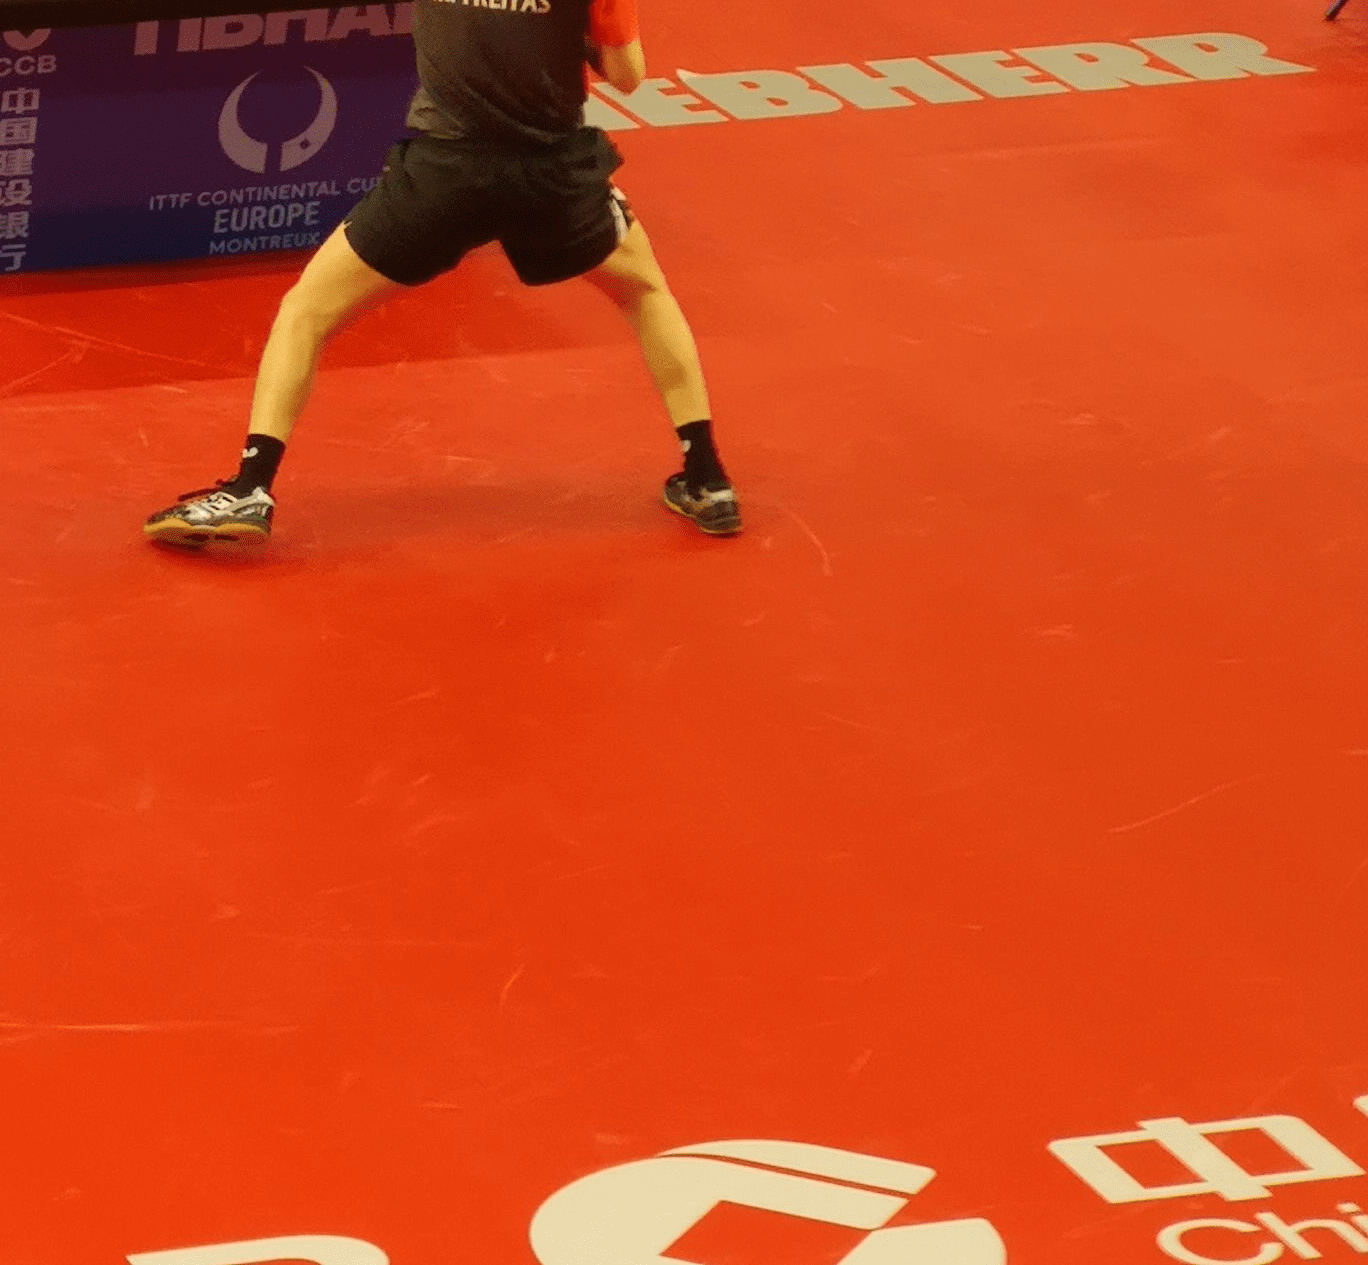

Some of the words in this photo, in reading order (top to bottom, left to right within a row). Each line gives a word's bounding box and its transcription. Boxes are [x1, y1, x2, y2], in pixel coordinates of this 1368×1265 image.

[134, 1, 413, 55] TIBHA
[149, 193, 192, 211] ITTF
[197, 181, 341, 207] CONTINENTAL
[213, 201, 321, 234] EUROPE
[209, 232, 320, 254] MONTREUX
